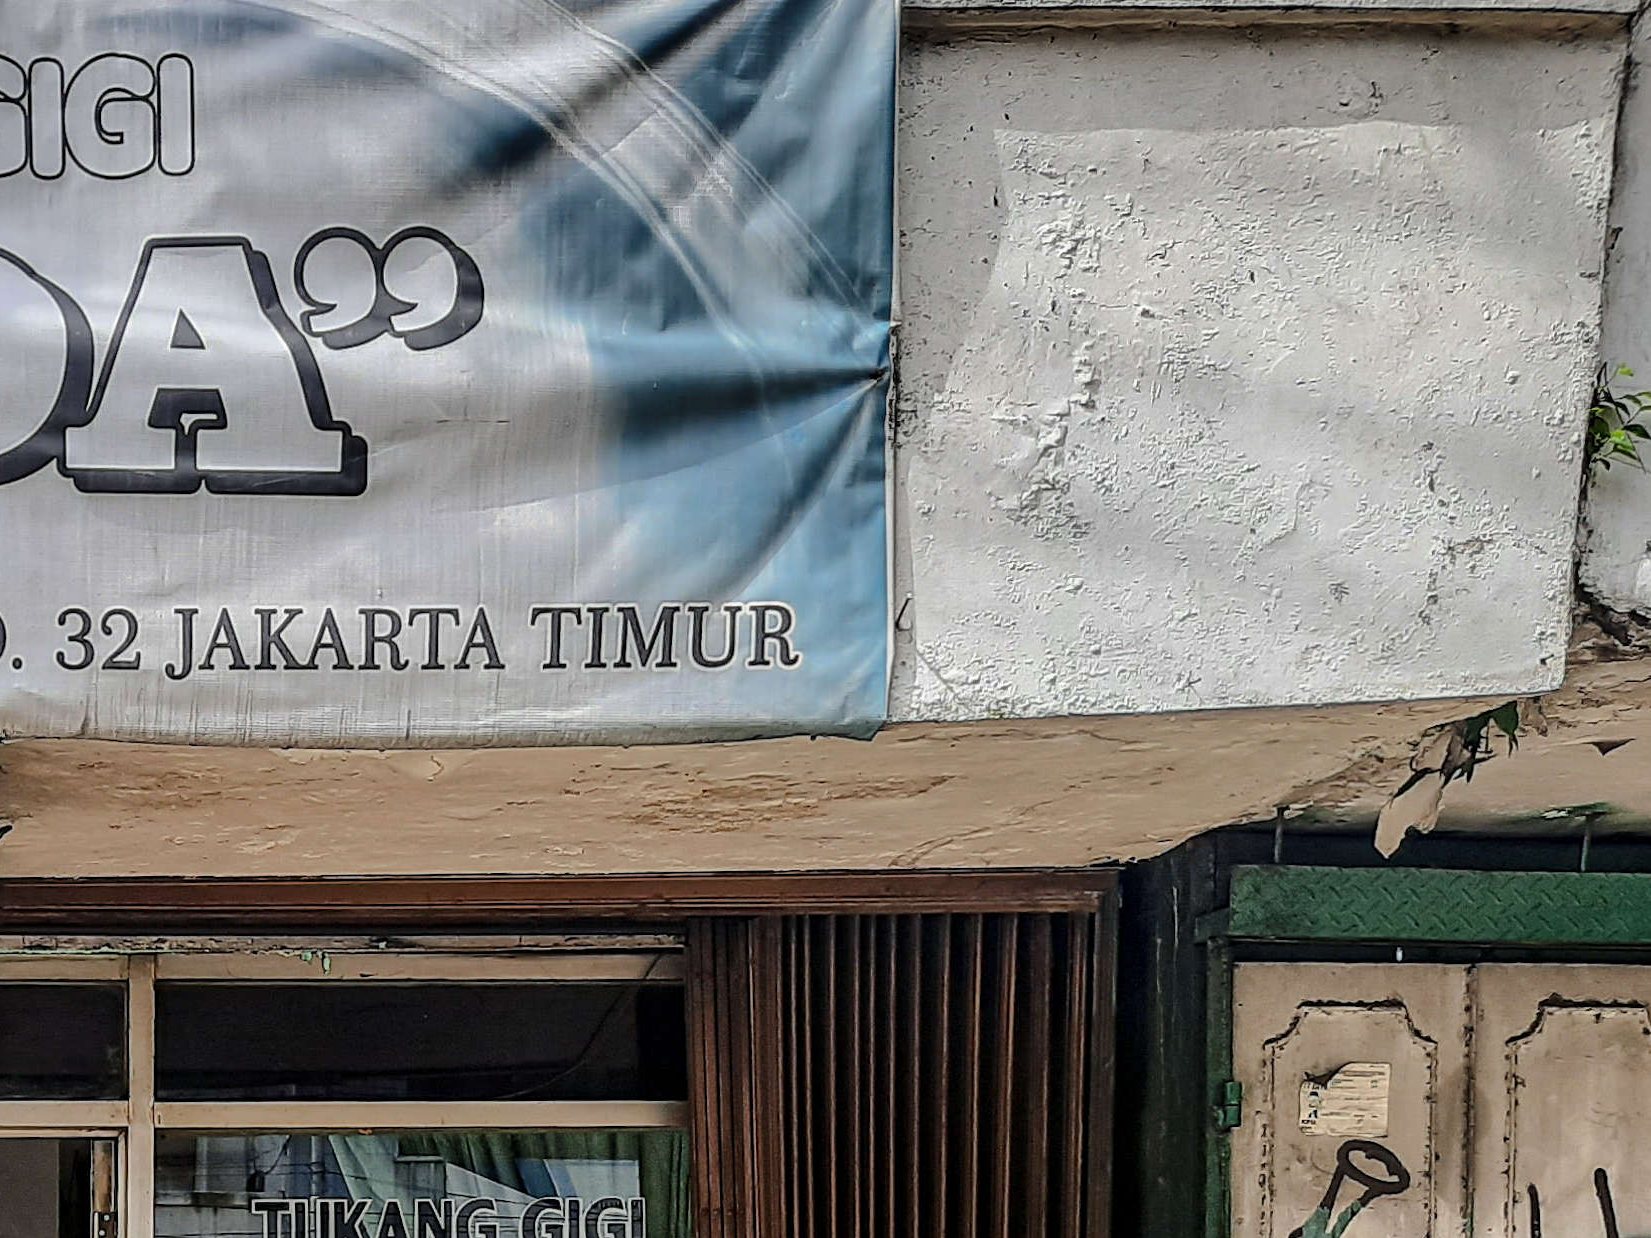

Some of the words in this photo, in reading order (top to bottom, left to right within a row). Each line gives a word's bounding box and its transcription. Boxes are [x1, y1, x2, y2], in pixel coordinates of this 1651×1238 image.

[53, 606, 143, 672] 32
[164, 603, 506, 682] JAKARTA
[529, 601, 800, 673] TIMUR
